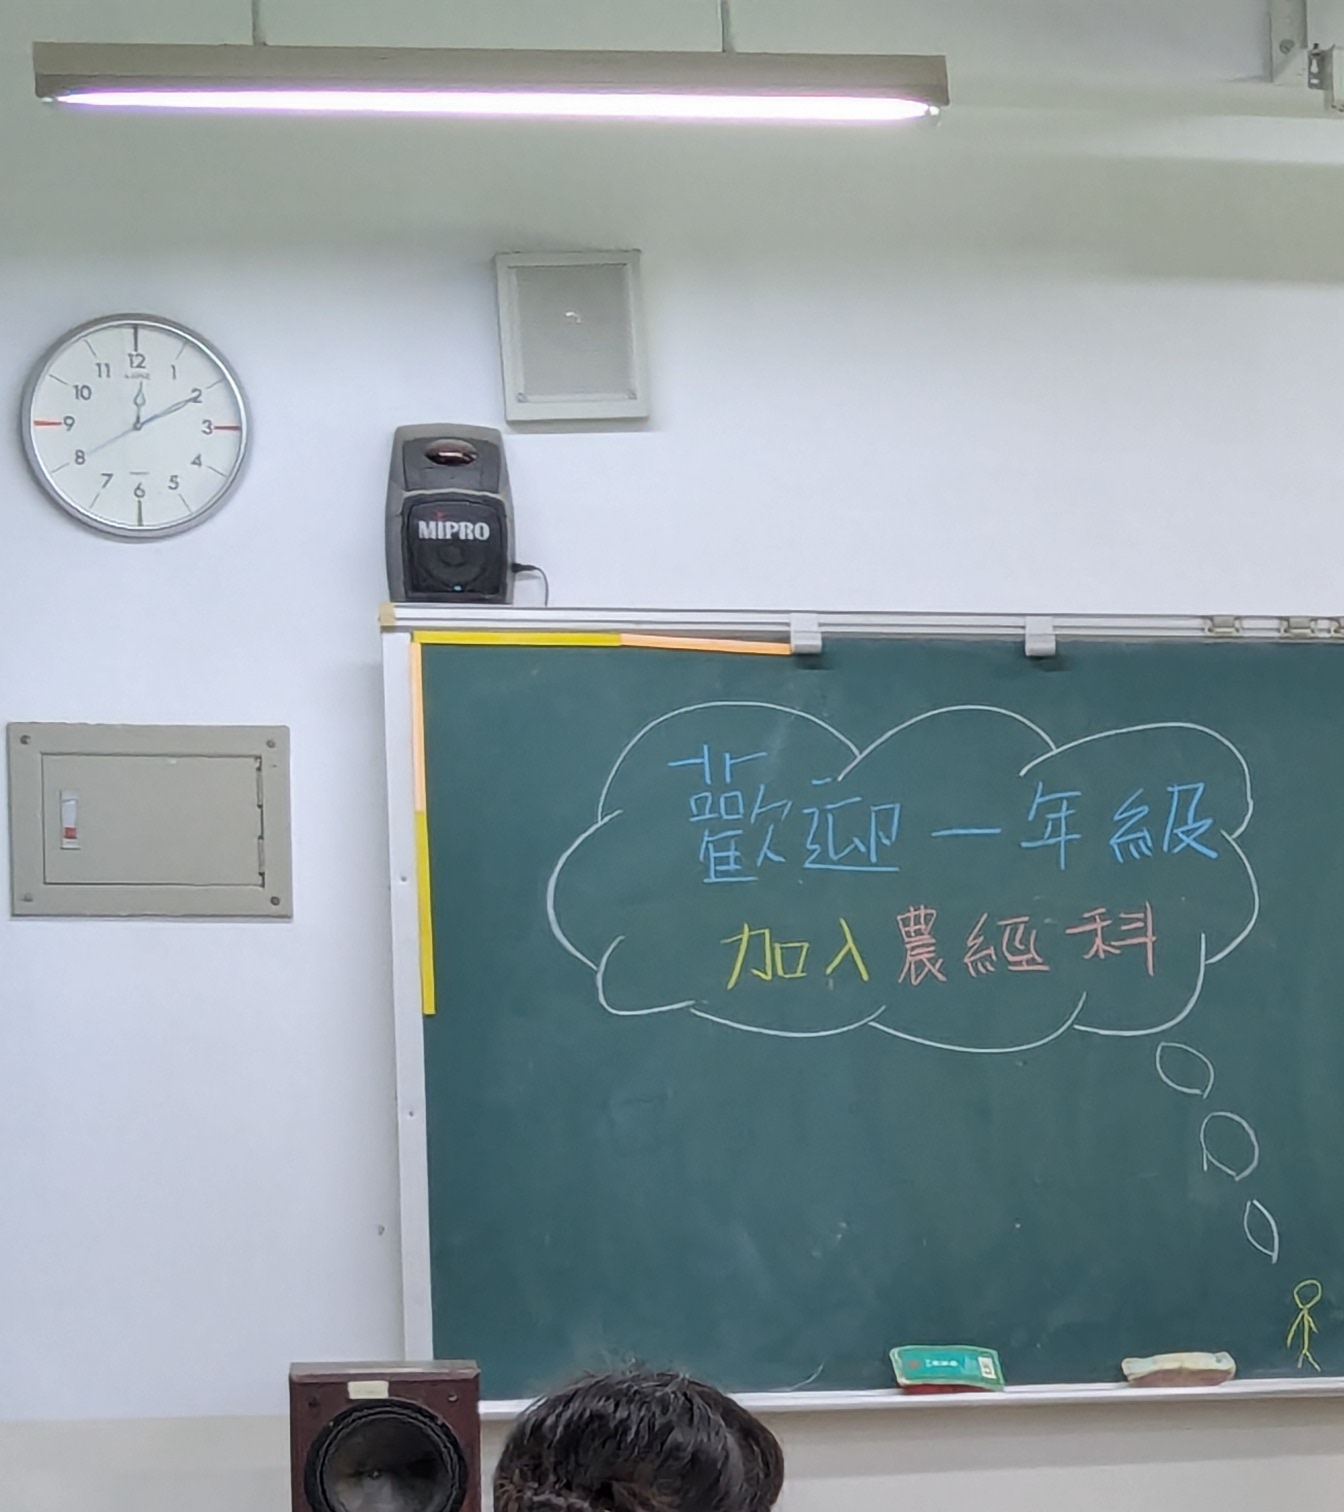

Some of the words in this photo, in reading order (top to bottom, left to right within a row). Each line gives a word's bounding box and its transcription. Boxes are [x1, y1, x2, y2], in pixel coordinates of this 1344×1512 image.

[128, 353, 146, 368] 12
[95, 362, 111, 378] 11
[170, 364, 177, 379] 1
[73, 384, 92, 400] 10
[191, 388, 203, 403] 2
[63, 415, 76, 431] 9
[201, 419, 214, 434] 3
[74, 449, 86, 465] 8
[190, 454, 203, 467] 4
[101, 473, 114, 489] 7
[168, 475, 180, 490] 5
[133, 482, 146, 498] 6
[418, 520, 491, 541] MIPRO
[667, 744, 1219, 883] 歡迎一年級
[720, 900, 1157, 991] 加入農經科
